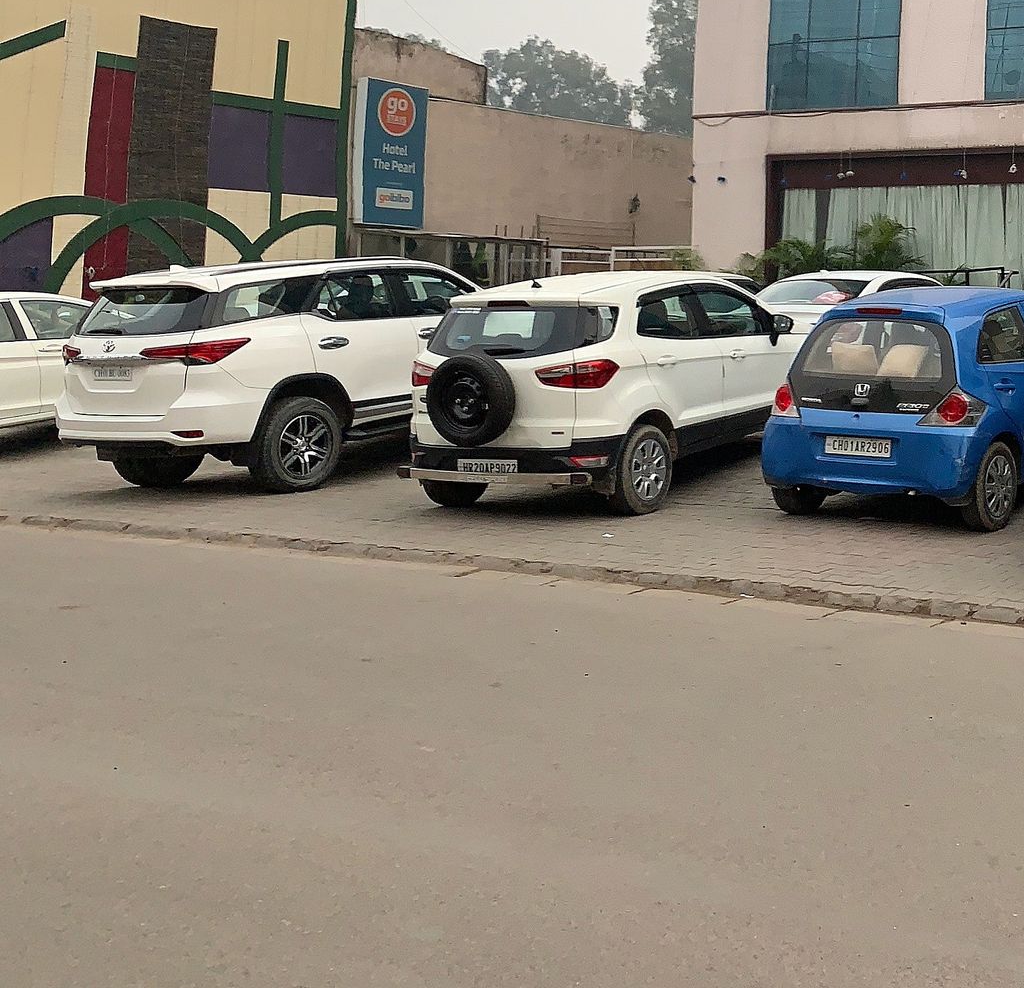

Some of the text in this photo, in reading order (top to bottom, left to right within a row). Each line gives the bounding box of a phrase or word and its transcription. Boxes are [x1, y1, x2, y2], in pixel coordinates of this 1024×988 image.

[387, 96, 409, 115] go
[382, 143, 408, 156] Hotel
[373, 158, 416, 174] The Pearl
[832, 439, 890, 454] CH01AR2906
